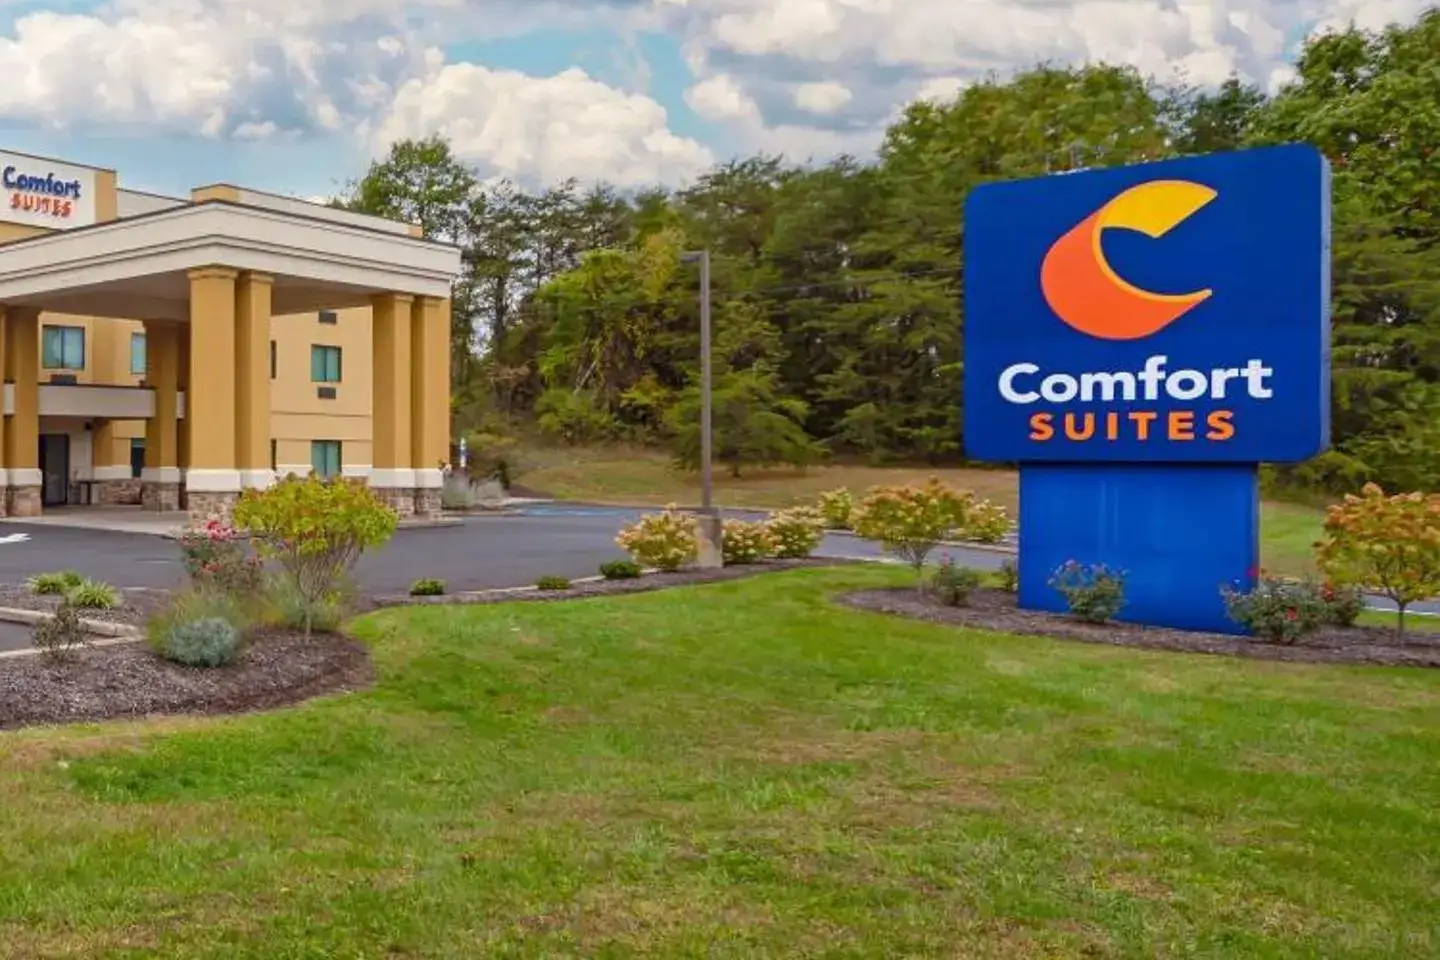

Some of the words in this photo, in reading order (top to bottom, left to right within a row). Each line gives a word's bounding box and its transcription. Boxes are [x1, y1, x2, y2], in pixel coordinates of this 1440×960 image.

[3, 166, 81, 198] Comfort
[12, 194, 72, 217] SUITES
[998, 355, 1273, 404] Comfort
[1028, 410, 1235, 441] SUITES
